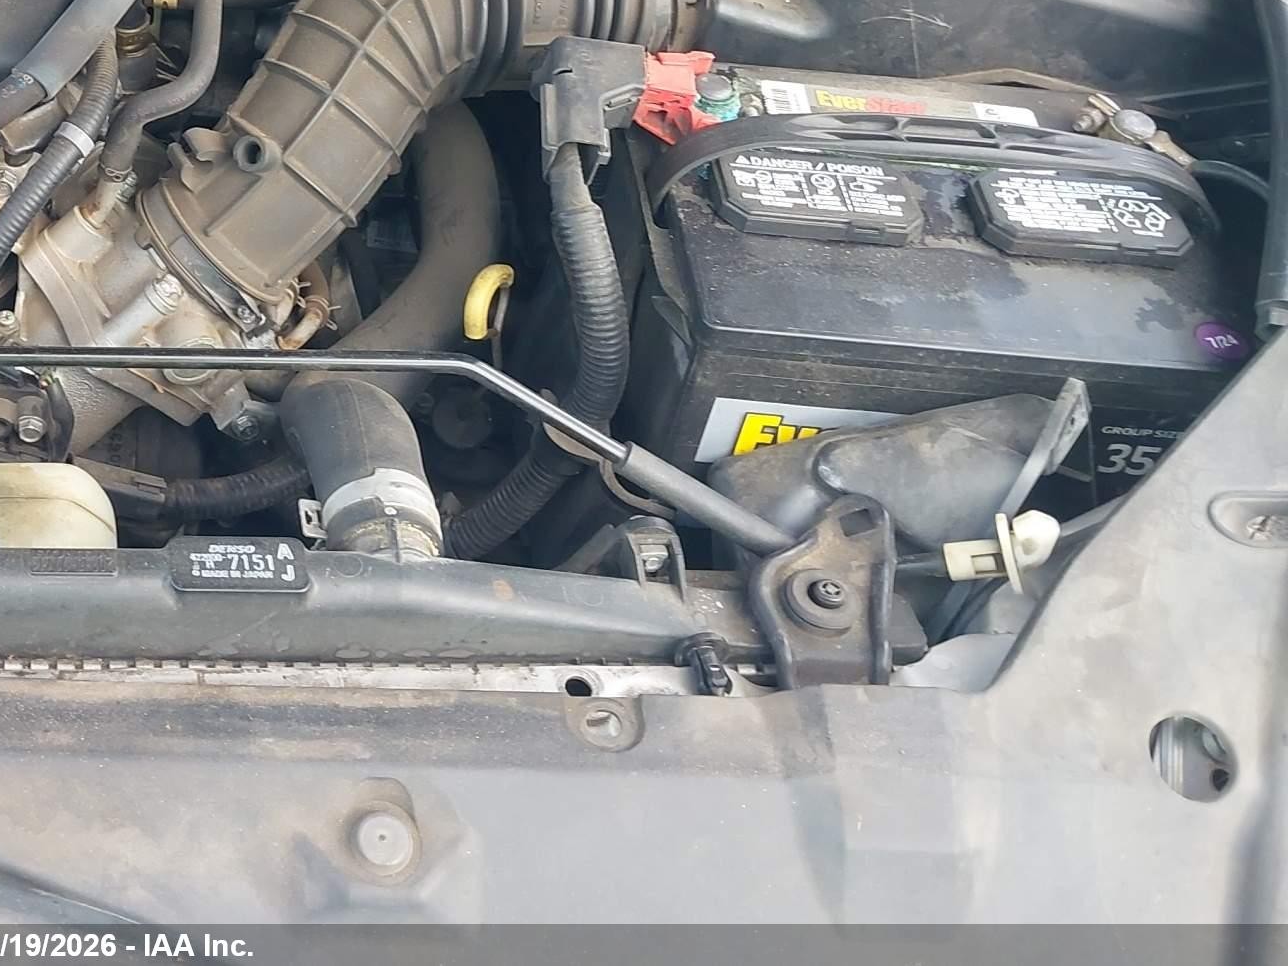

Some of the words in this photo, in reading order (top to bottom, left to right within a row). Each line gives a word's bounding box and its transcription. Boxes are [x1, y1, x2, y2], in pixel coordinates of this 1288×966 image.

[815, 90, 926, 115] EverStart
[749, 156, 814, 171] DANGER
[827, 163, 885, 176] POISON
[1101, 425, 1153, 437] GROUP
[1097, 444, 1162, 475] 35
[208, 544, 256, 554] DENSO
[276, 542, 295, 560] A
[280, 564, 296, 582] J
